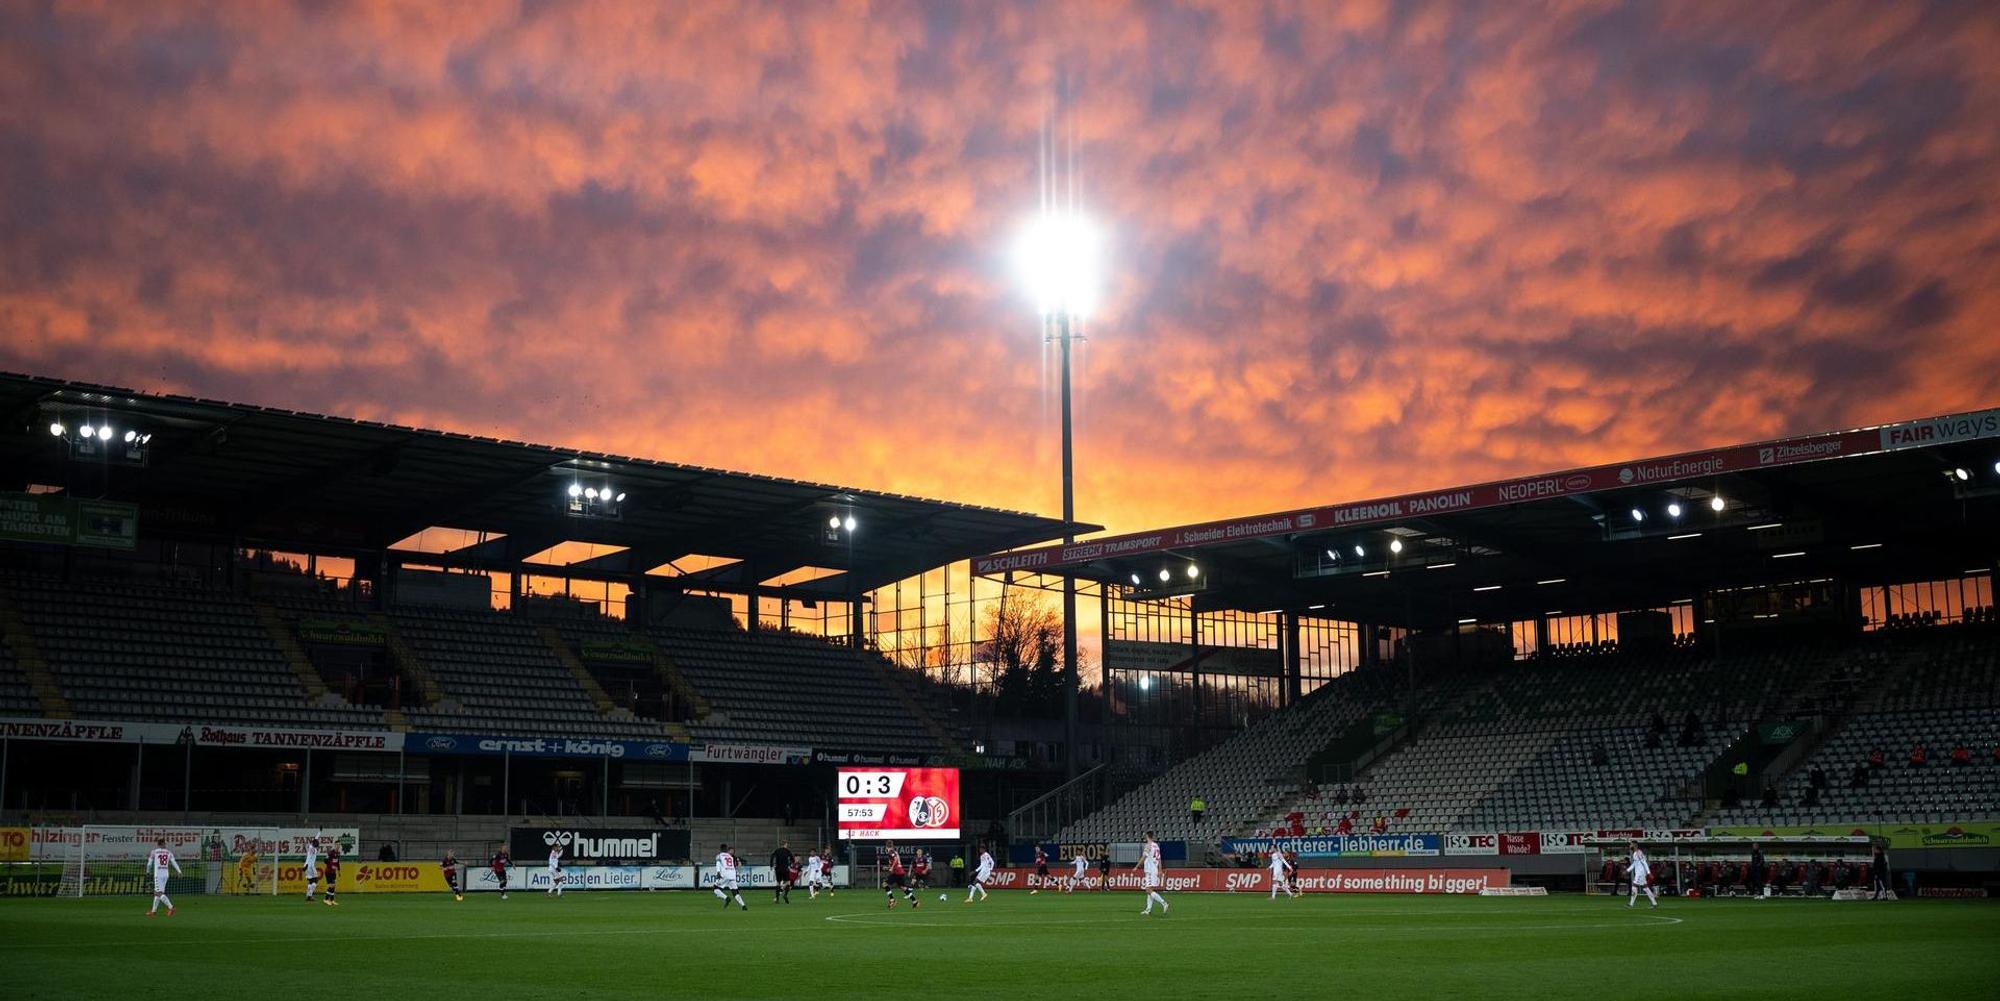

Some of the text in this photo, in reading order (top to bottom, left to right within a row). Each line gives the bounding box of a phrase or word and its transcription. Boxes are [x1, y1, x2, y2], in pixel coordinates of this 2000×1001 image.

[1891, 416, 1998, 444] FAIR ways
[1777, 441, 1843, 458] Zitzelsberger
[1637, 456, 1724, 480] NaturEnergie
[1499, 478, 1564, 501] NEOPERL
[1335, 493, 1471, 523] KLEENOIL PANOLIN
[1184, 526, 1225, 543] Schneider
[1227, 518, 1292, 537] Elektrotechnik
[1105, 537, 1161, 553] TRANSPORT
[992, 553, 1048, 570] SCHLEITH
[200, 727, 386, 749] Rothaus TANNENZÄPFLE
[480, 740, 546, 752] ernst
[565, 740, 625, 758] könig
[707, 747, 784, 763] Furtwängler
[848, 809, 874, 818] 57:53
[102, 834, 134, 843] Fenster
[574, 831, 658, 858] hummel
[158, 855, 168, 866] 18
[376, 867, 420, 880] LOTTO
[532, 874, 550, 885] Am
[605, 872, 638, 885] Lieler.
[1226, 873, 1488, 893] SMP part of something bigger!
